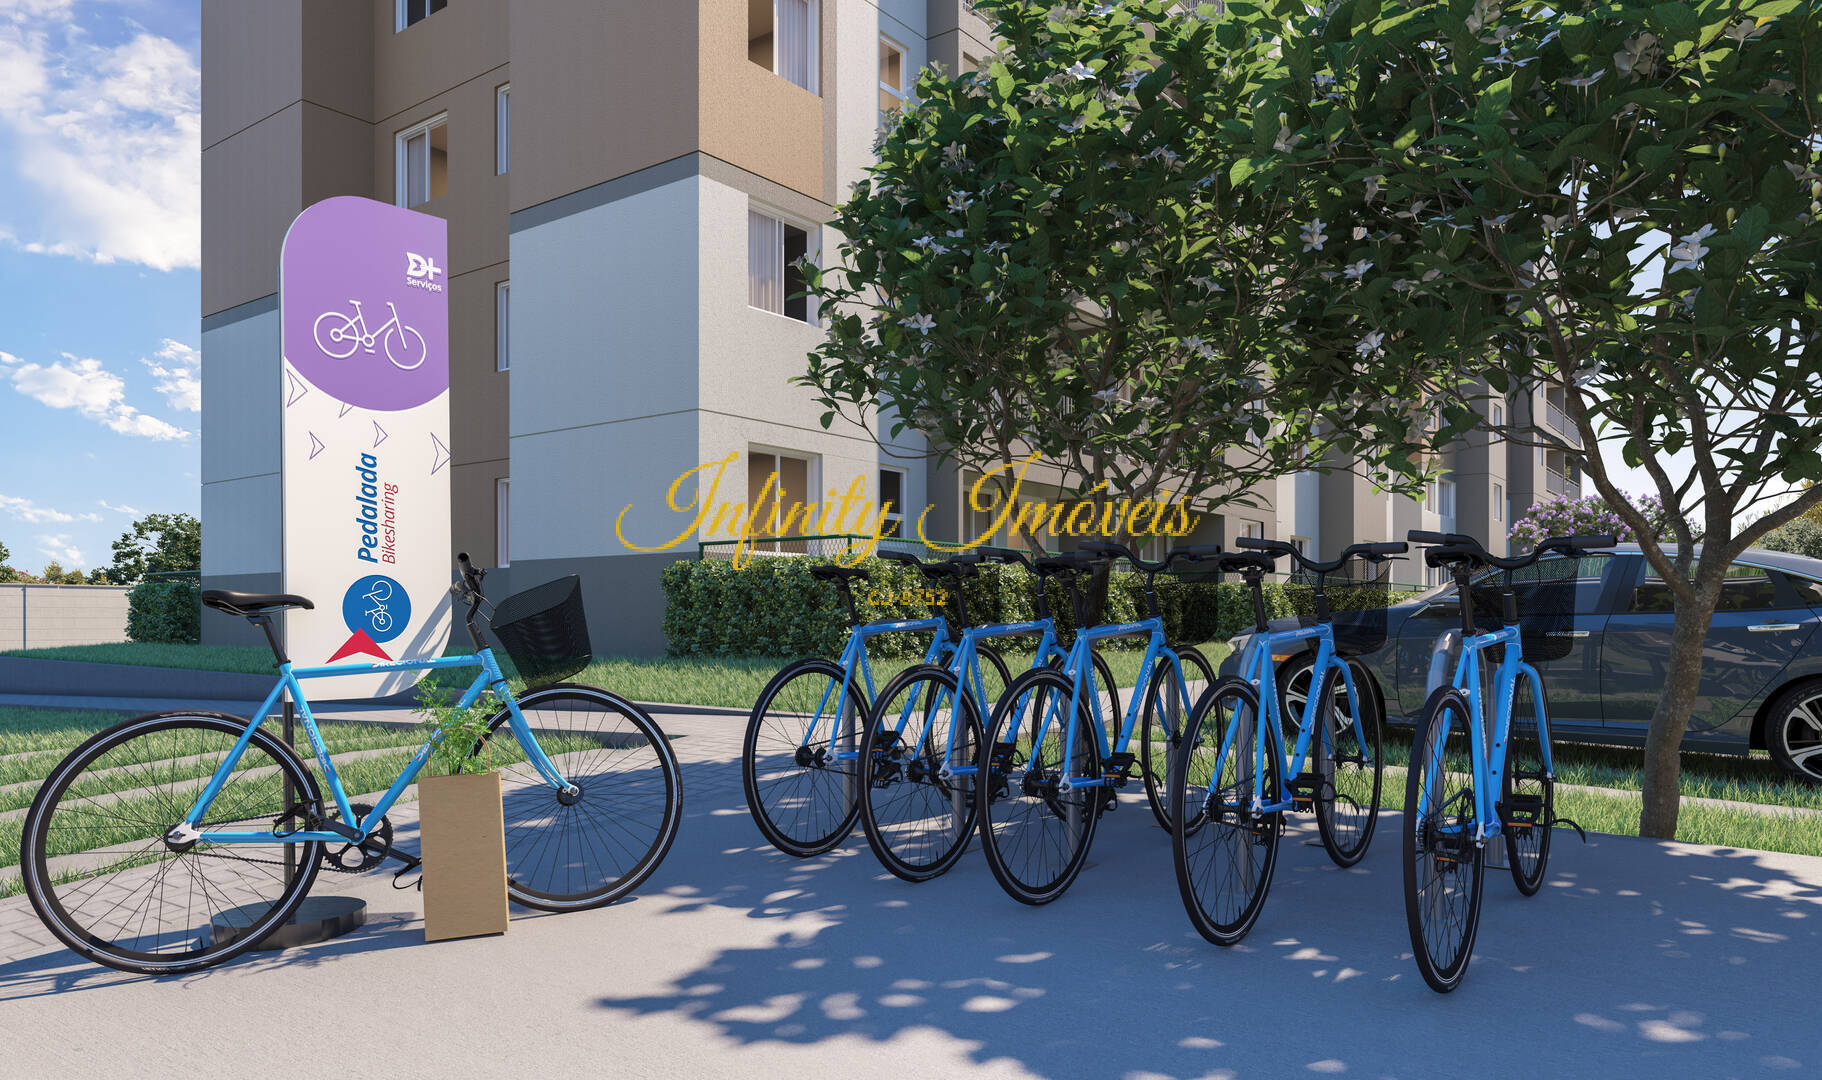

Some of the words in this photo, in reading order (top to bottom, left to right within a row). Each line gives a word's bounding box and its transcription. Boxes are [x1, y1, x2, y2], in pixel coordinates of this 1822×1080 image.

[406, 276, 442, 292] Serviços
[355, 452, 379, 564] Pedalada
[381, 481, 399, 565] Bikesharing
[300, 704, 331, 774] DIRECIONAL
